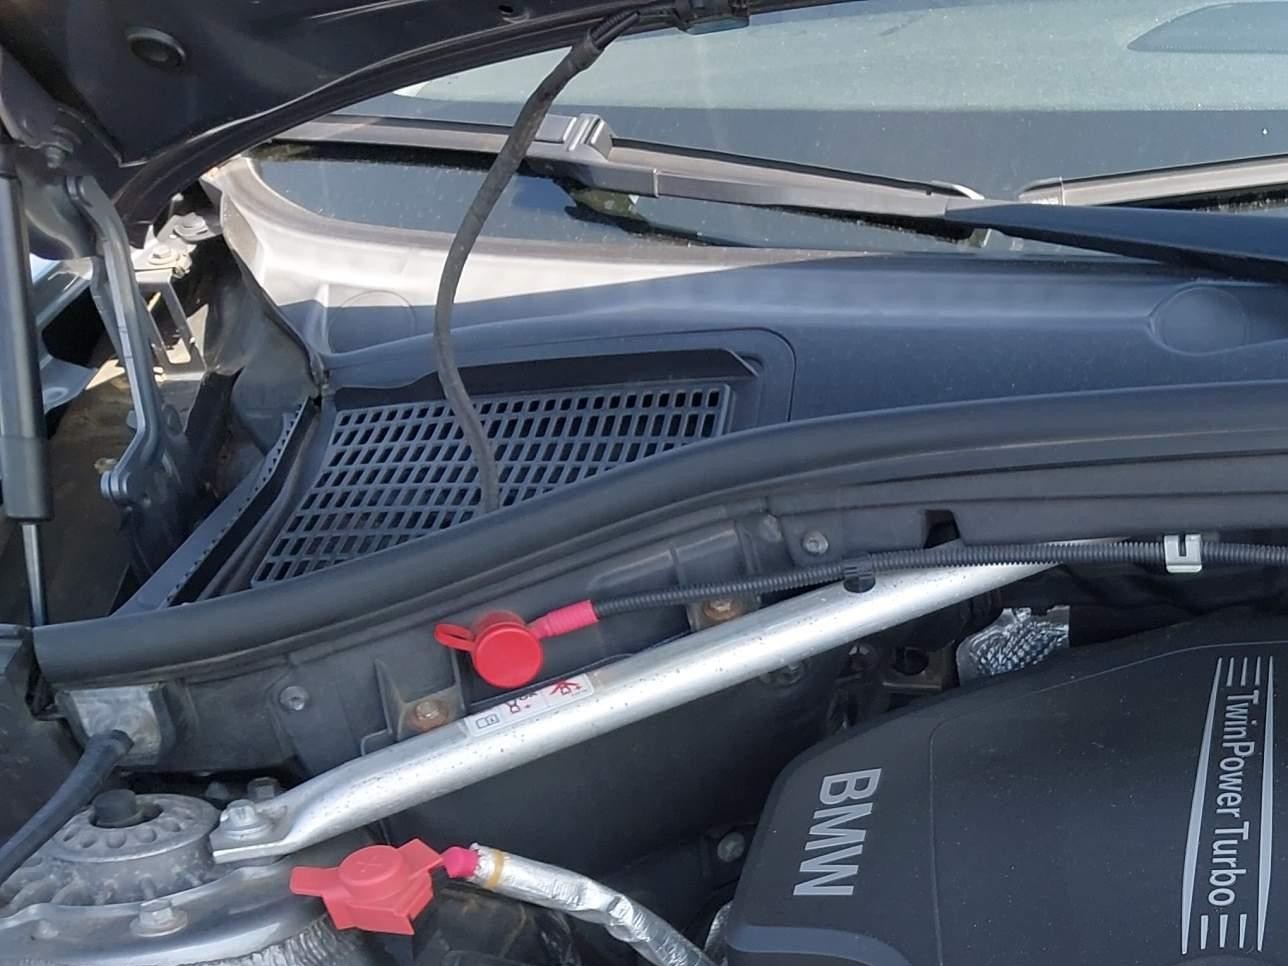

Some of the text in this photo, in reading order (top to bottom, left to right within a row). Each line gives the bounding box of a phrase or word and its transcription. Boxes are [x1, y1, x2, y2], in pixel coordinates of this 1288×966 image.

[792, 768, 883, 896] BMW
[1207, 689, 1260, 907] TwinPower Turbo
